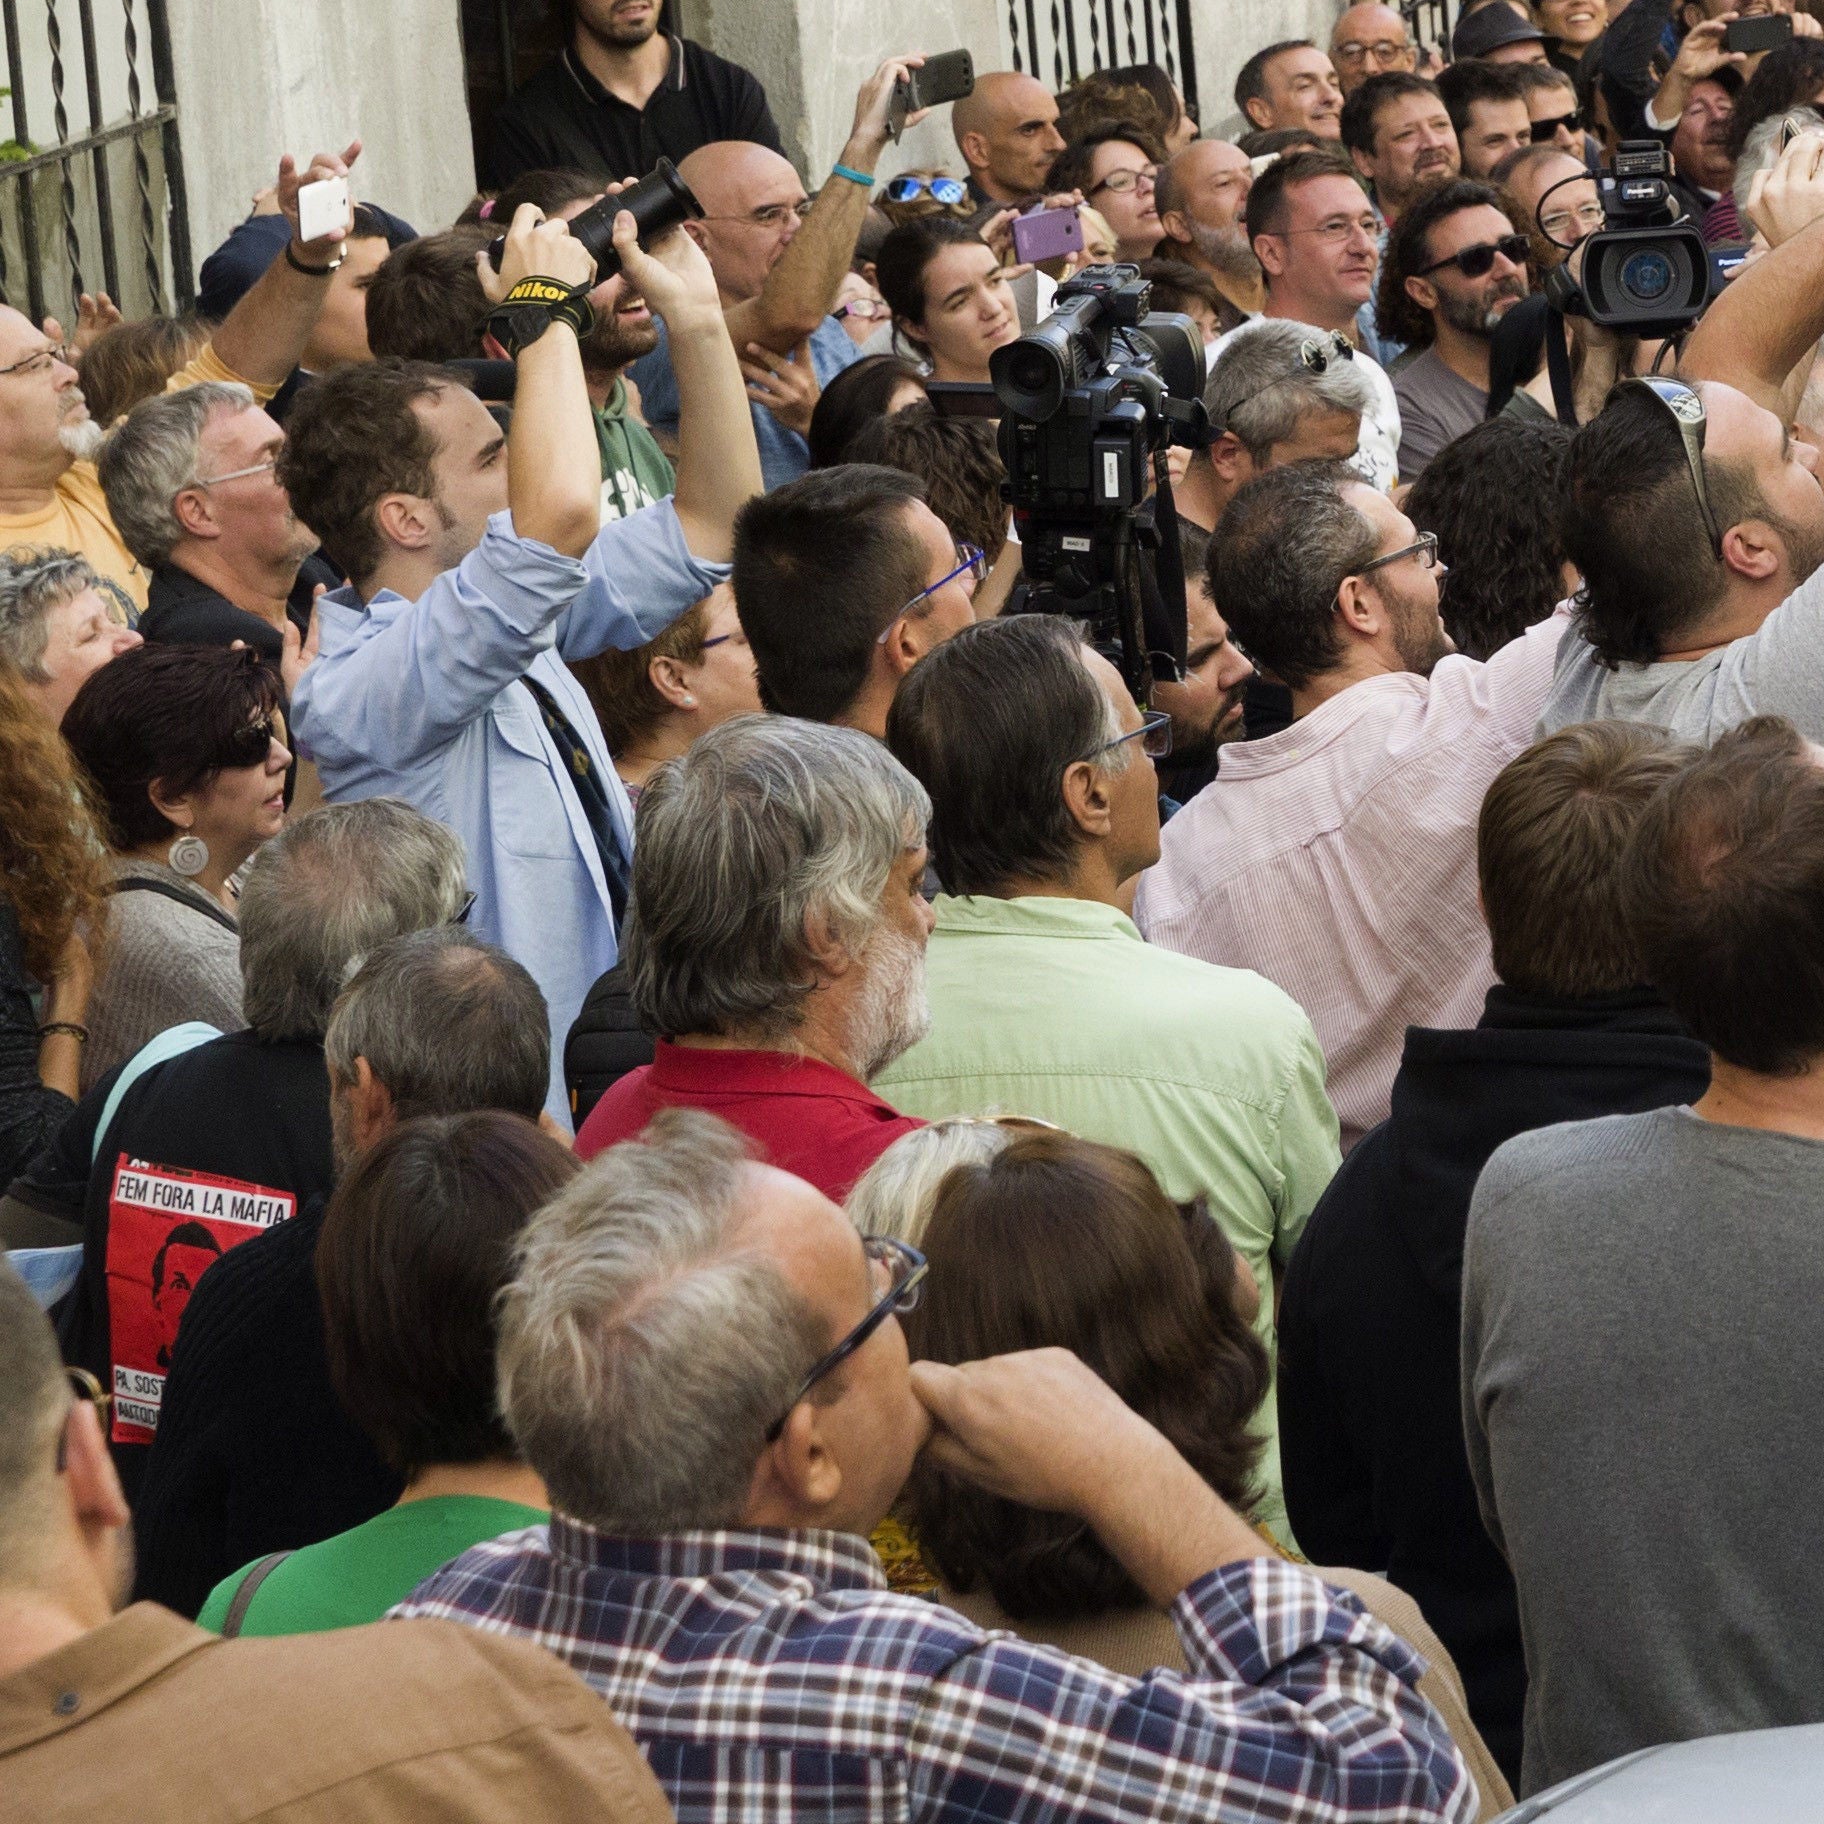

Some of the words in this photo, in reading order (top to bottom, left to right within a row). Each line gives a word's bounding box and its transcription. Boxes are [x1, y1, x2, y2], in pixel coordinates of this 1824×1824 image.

[117, 1175, 148, 1203] FEM
[152, 1182, 195, 1212] FORA
[202, 1191, 224, 1216] LA
